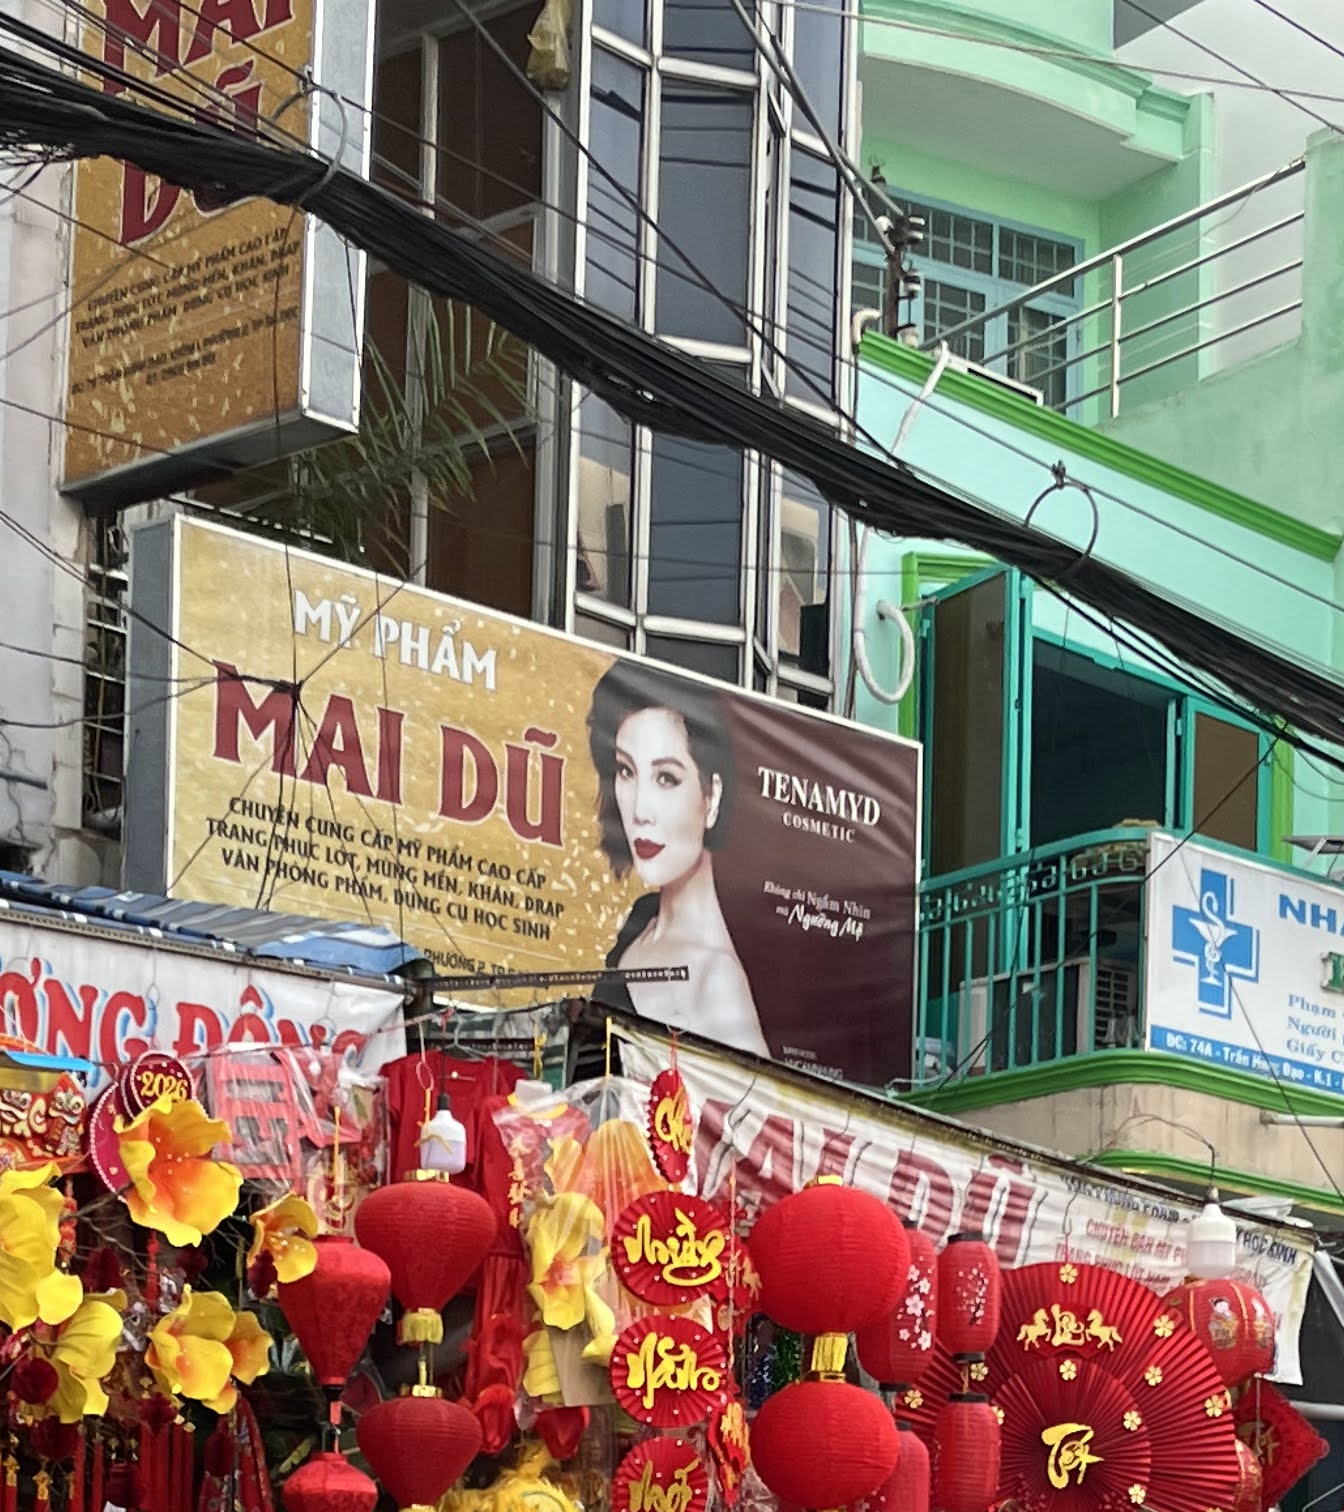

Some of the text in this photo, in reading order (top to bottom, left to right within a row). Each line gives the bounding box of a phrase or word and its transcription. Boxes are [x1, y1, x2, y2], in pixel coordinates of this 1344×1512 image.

[294, 588, 497, 692] MỸ PHẨM
[212, 659, 564, 848] MAI DŨ
[758, 766, 881, 826] TENAMYD
[229, 796, 300, 830] CHUYÊN
[305, 815, 355, 843] CUNG
[426, 845, 473, 872] PHẨM
[477, 858, 512, 883] CAO
[782, 811, 855, 843] COSMETIC
[206, 816, 267, 848] TRANG
[523, 896, 566, 920] DRAP
[221, 845, 259, 872] VĂN
[265, 857, 329, 890] PHÒNG
[473, 906, 507, 930] HỌC
[513, 916, 552, 941] SINH
[1287, 1015, 1337, 1040] Người
[1288, 994, 1337, 1020] Phạm
[1190, 1037, 1213, 1057] 74A
[1286, 1038, 1325, 1062] Giấy
[140, 1068, 189, 1101] 2026
